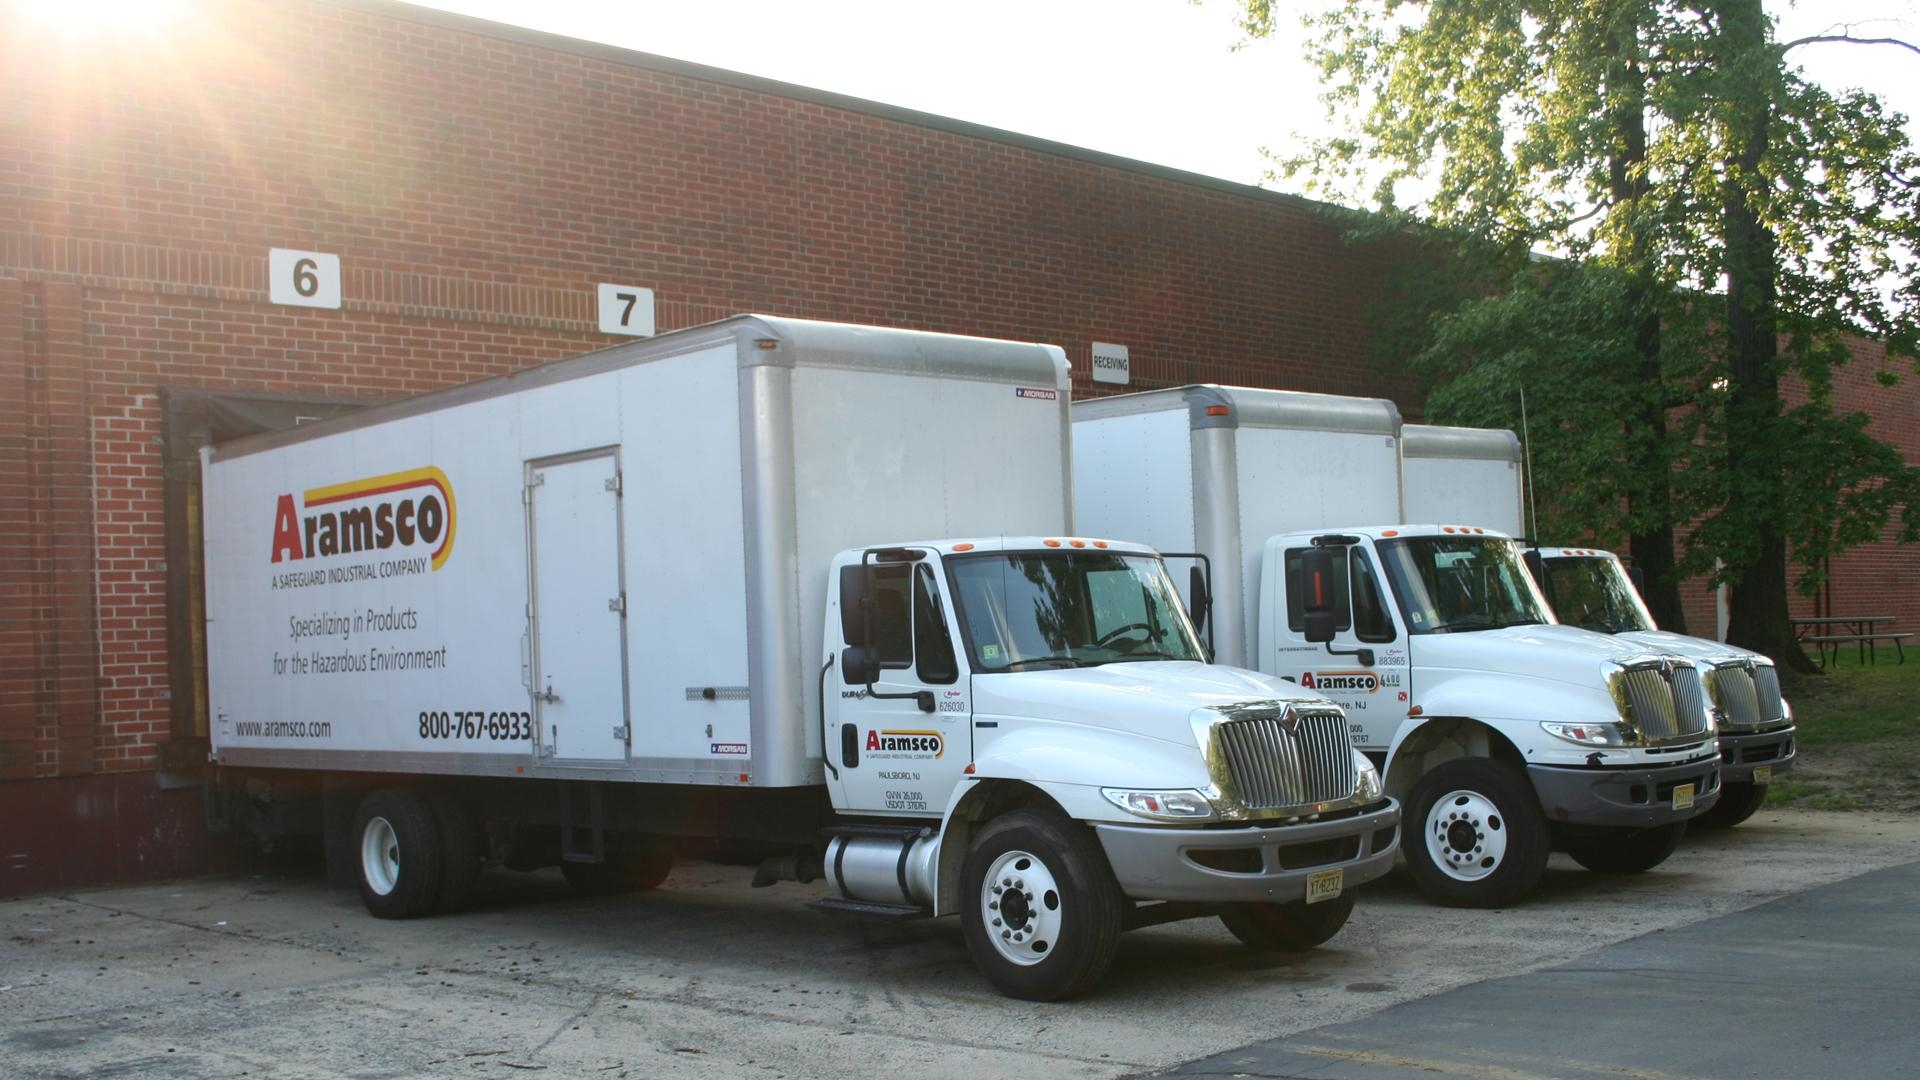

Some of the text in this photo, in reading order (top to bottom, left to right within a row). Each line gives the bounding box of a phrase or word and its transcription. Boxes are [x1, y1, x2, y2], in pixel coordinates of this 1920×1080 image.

[293, 258, 318, 297] 6
[616, 292, 637, 326] 7
[1094, 355, 1128, 371] RECEIVING
[1023, 389, 1055, 399] MORGAN
[271, 493, 443, 564] Aramsco
[272, 557, 427, 590] A SAFEGUARD INDUSTRIAL COMPANY
[289, 605, 417, 643] Specializing in Products
[273, 645, 446, 676] for the Hazardous Environment
[1379, 656, 1405, 666] 883965
[1301, 672, 1376, 689] Aramsco
[940, 701, 965, 712] 626030
[1355, 701, 1367, 709] NJ
[236, 720, 331, 738] www.aramsco.com
[419, 711, 531, 740] 800-767-6933
[717, 745, 746, 753] MORGAN
[866, 730, 939, 752] Aramsco
[878, 771, 921, 780] PAULSBORO, NJ
[885, 791, 901, 800] GVW
[885, 801, 905, 809] USDOT
